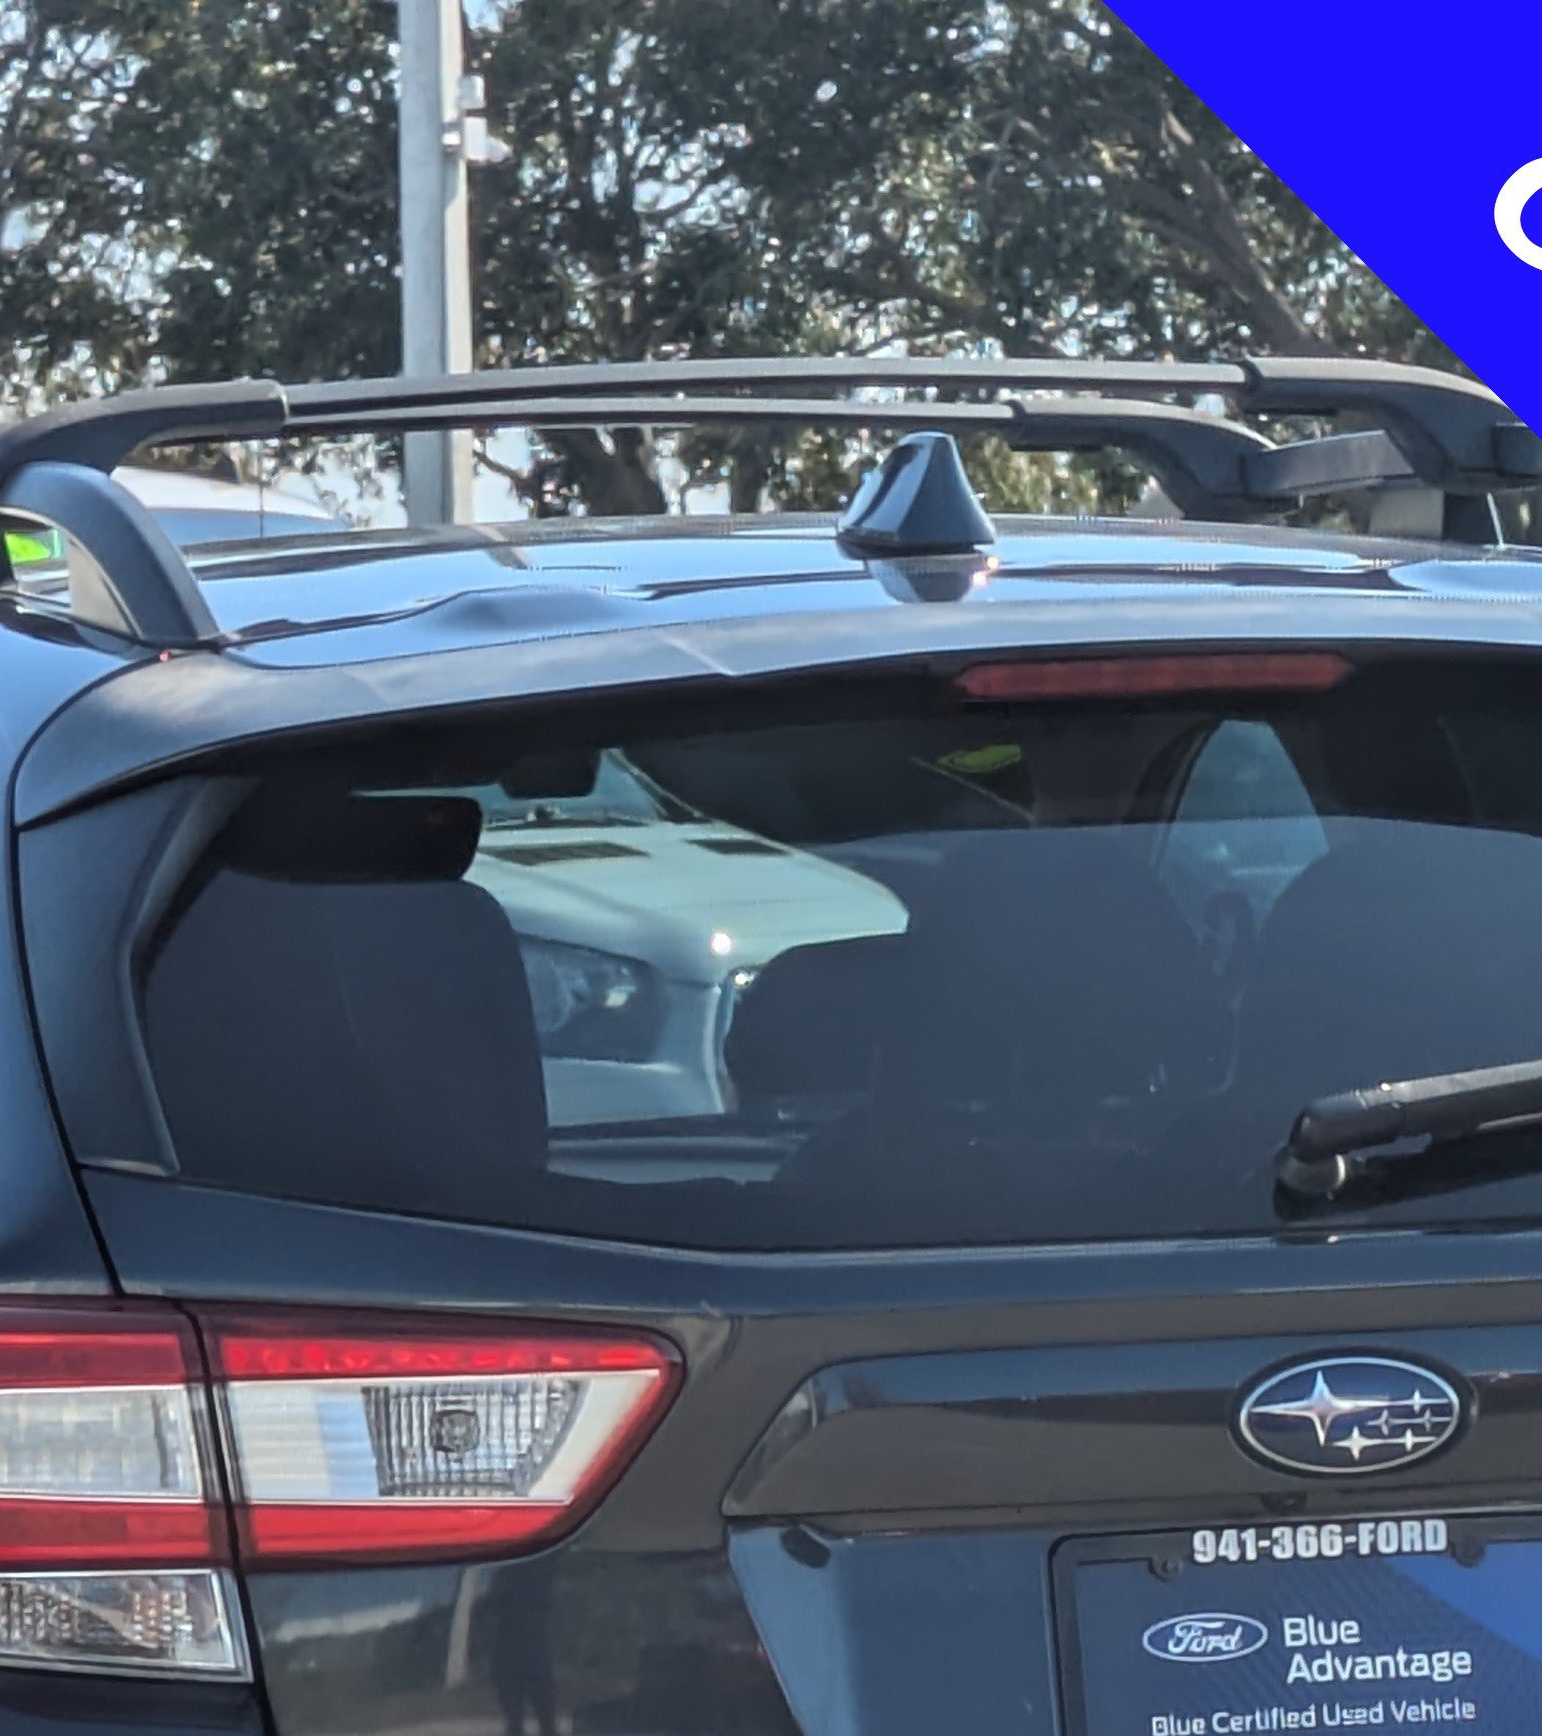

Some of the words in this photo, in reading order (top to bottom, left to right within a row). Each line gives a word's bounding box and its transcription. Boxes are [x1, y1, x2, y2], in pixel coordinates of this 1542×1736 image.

[1191, 1518, 1448, 1564] 941-366-FORD
[1167, 1620, 1244, 1655] Ford
[1283, 1614, 1360, 1648] Blue
[1286, 1645, 1473, 1687] Advantage
[1211, 1703, 1316, 1735] Certified
[1322, 1700, 1384, 1728] Used
[1389, 1696, 1477, 1724] Vehicle
